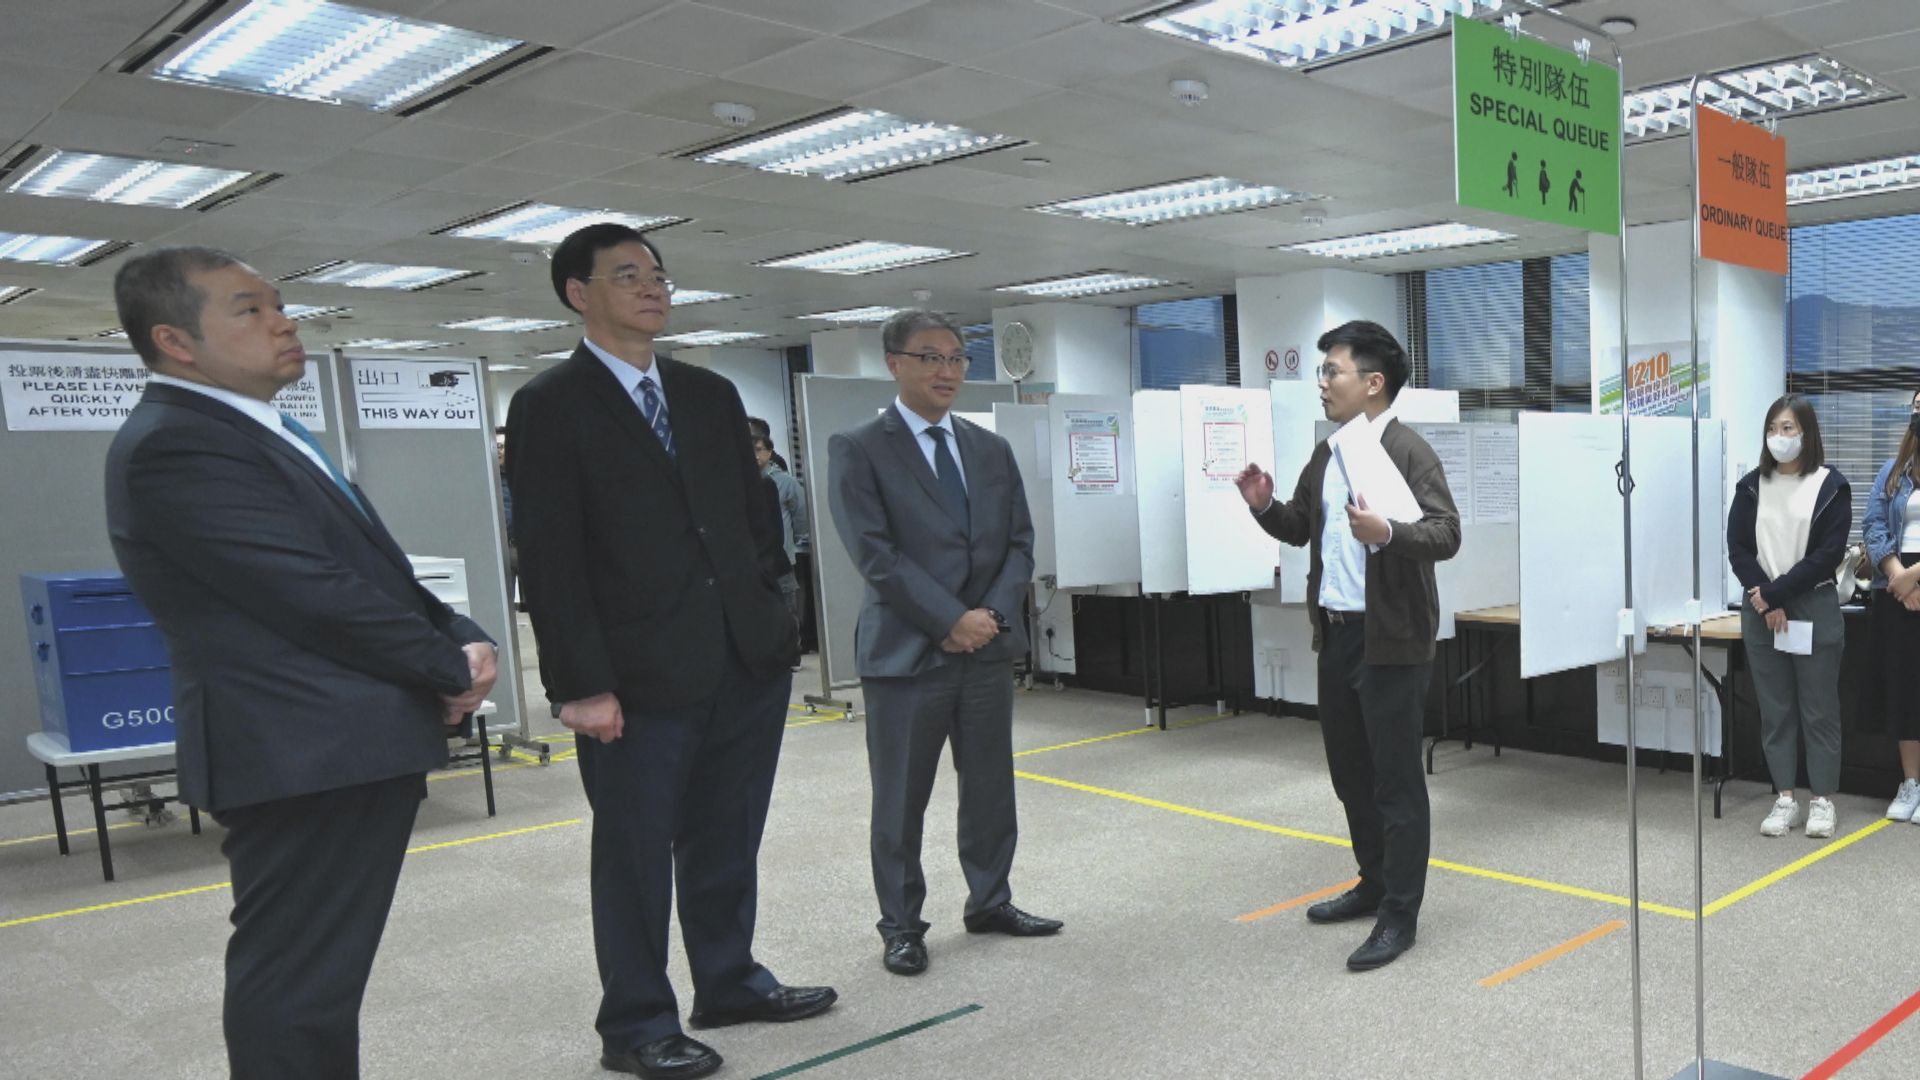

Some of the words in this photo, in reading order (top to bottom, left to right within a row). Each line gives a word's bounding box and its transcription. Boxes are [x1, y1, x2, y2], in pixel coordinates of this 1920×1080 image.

[1492, 46, 1590, 109] 特別隊伍
[1470, 92, 1549, 134] SPECIAL
[1553, 118, 1609, 151] QUEUE
[1718, 150, 1771, 189] 一般隊伍
[1701, 203, 1753, 232] ORDINARY
[1755, 218, 1787, 241] QUEUE
[22, 381, 88, 391] PLEASE
[358, 368, 399, 386] 出口
[51, 394, 122, 404] QUICKLY
[28, 406, 83, 416] AFTER
[361, 408, 399, 419] THIS
[402, 408, 439, 419] WAY
[444, 408, 475, 419] OUT
